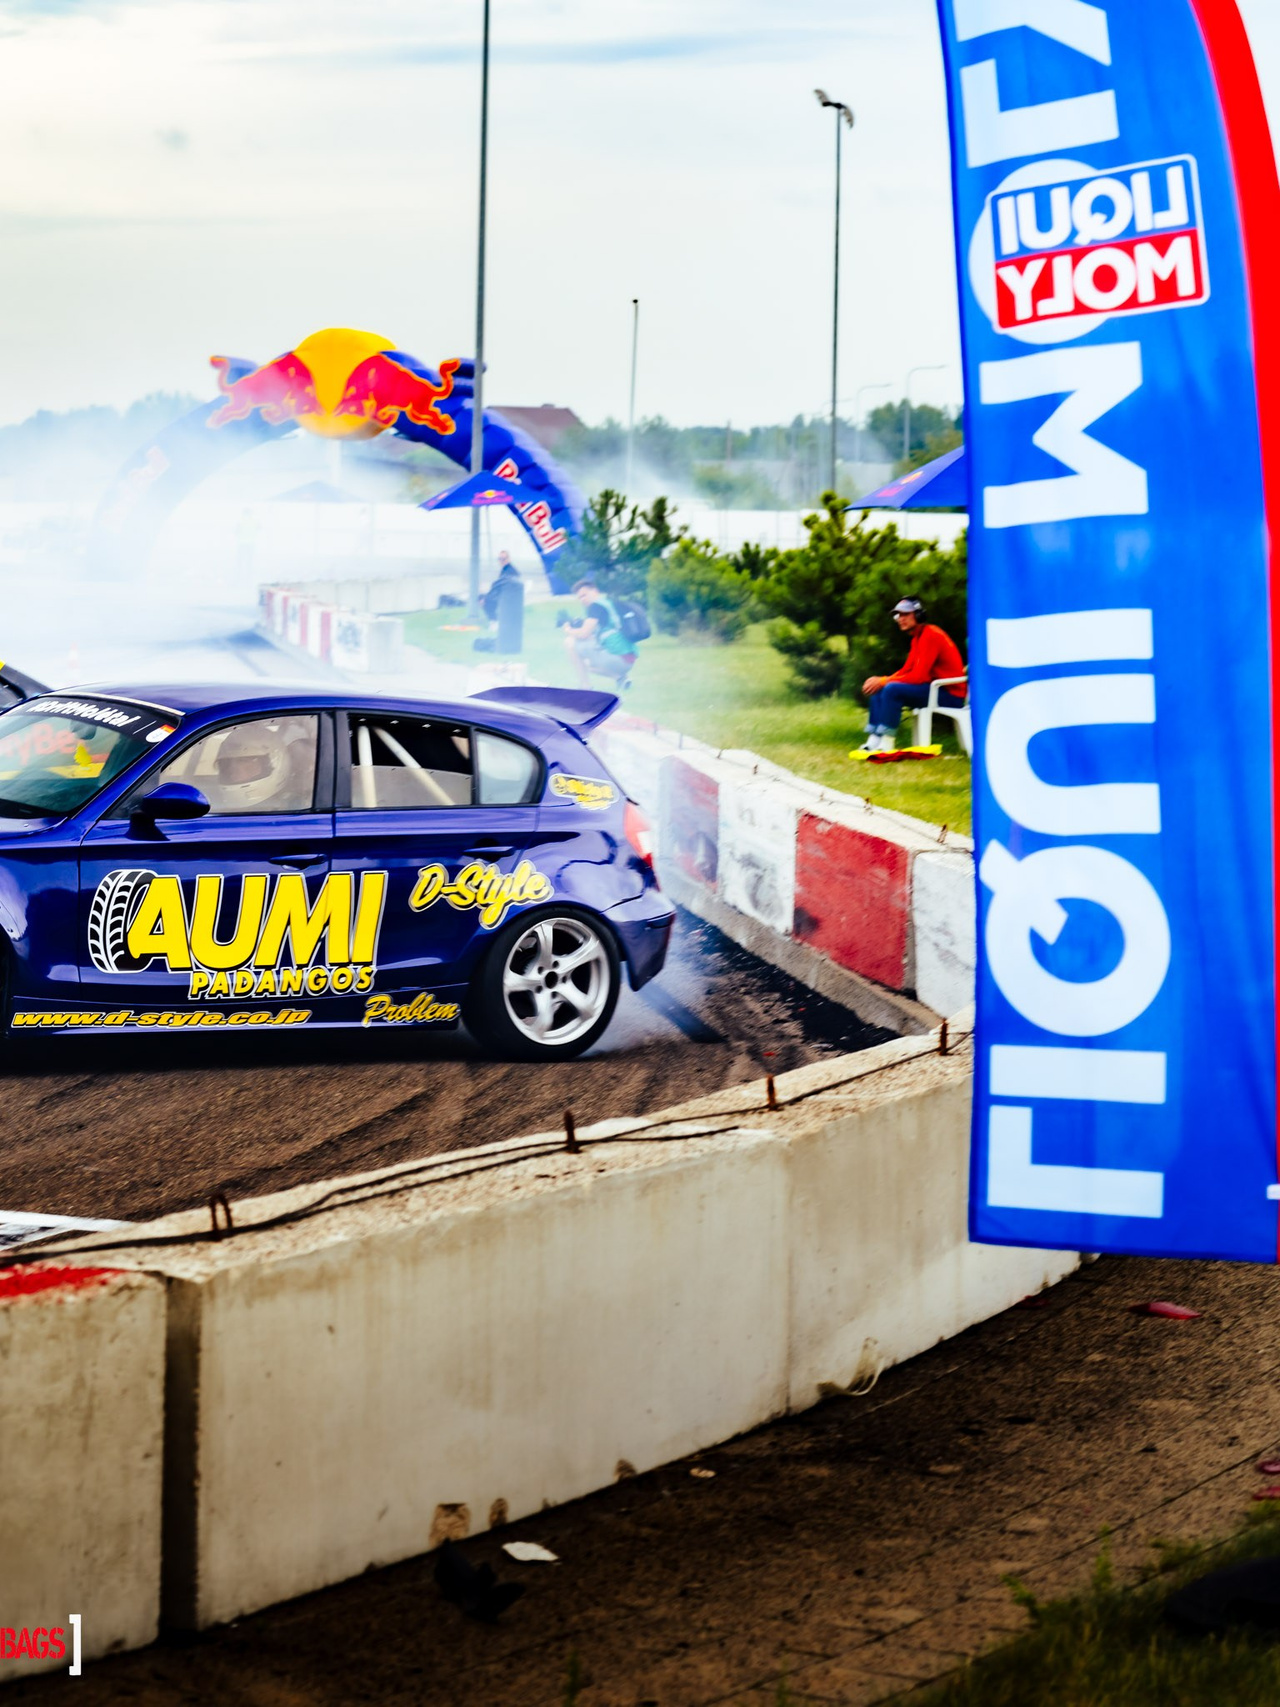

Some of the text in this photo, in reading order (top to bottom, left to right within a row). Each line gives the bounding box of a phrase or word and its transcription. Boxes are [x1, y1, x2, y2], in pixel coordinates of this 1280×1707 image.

[409, 860, 554, 929] D-Style
[126, 872, 389, 971] AUMI
[188, 965, 377, 999] PADANGOS
[12, 1009, 312, 1028] www.d-style.co.jp
[362, 994, 460, 1027] Problem
